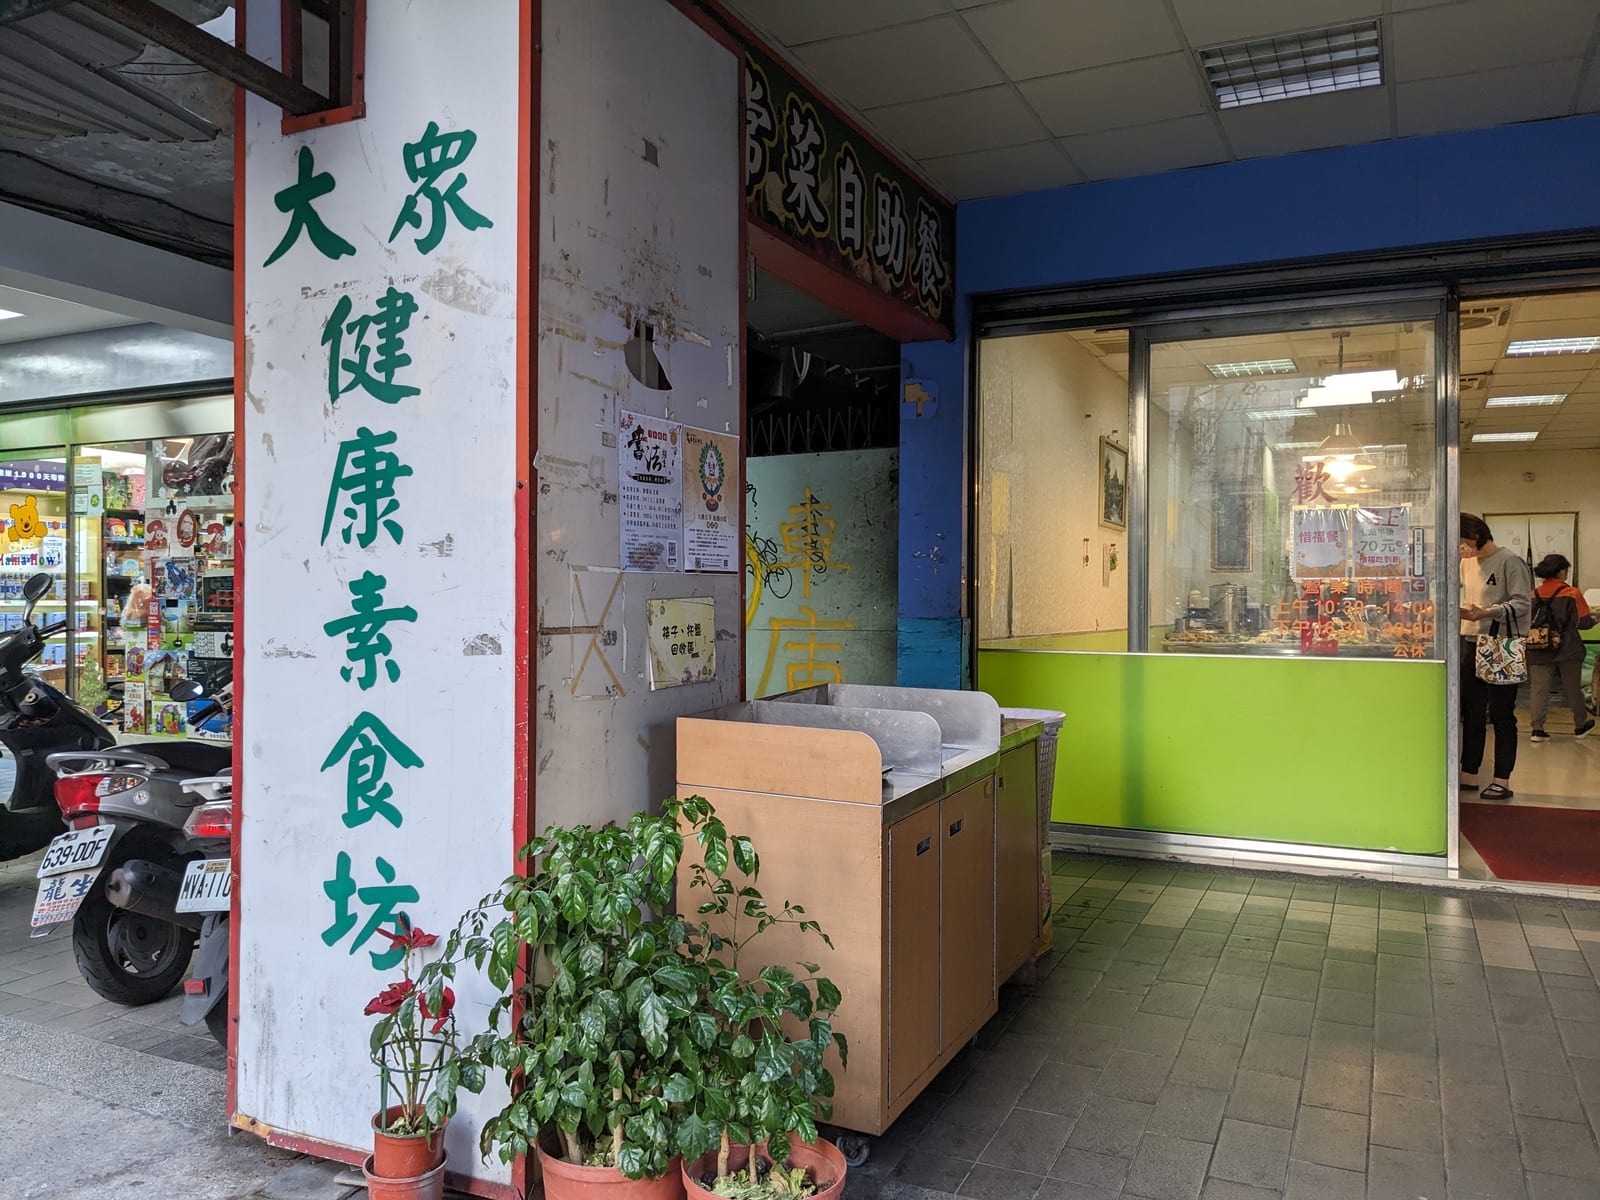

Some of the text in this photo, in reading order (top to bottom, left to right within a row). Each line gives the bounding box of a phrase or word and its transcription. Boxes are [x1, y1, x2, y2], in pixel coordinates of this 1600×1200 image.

[1299, 530, 1339, 543] 惜福餐
[1487, 573, 1497, 586] A
[1304, 580, 1402, 594] 營業時間
[320, 286, 425, 971] 健康素食坊
[1393, 644, 1426, 658] 公休
[42, 838, 107, 870] 639-DDF
